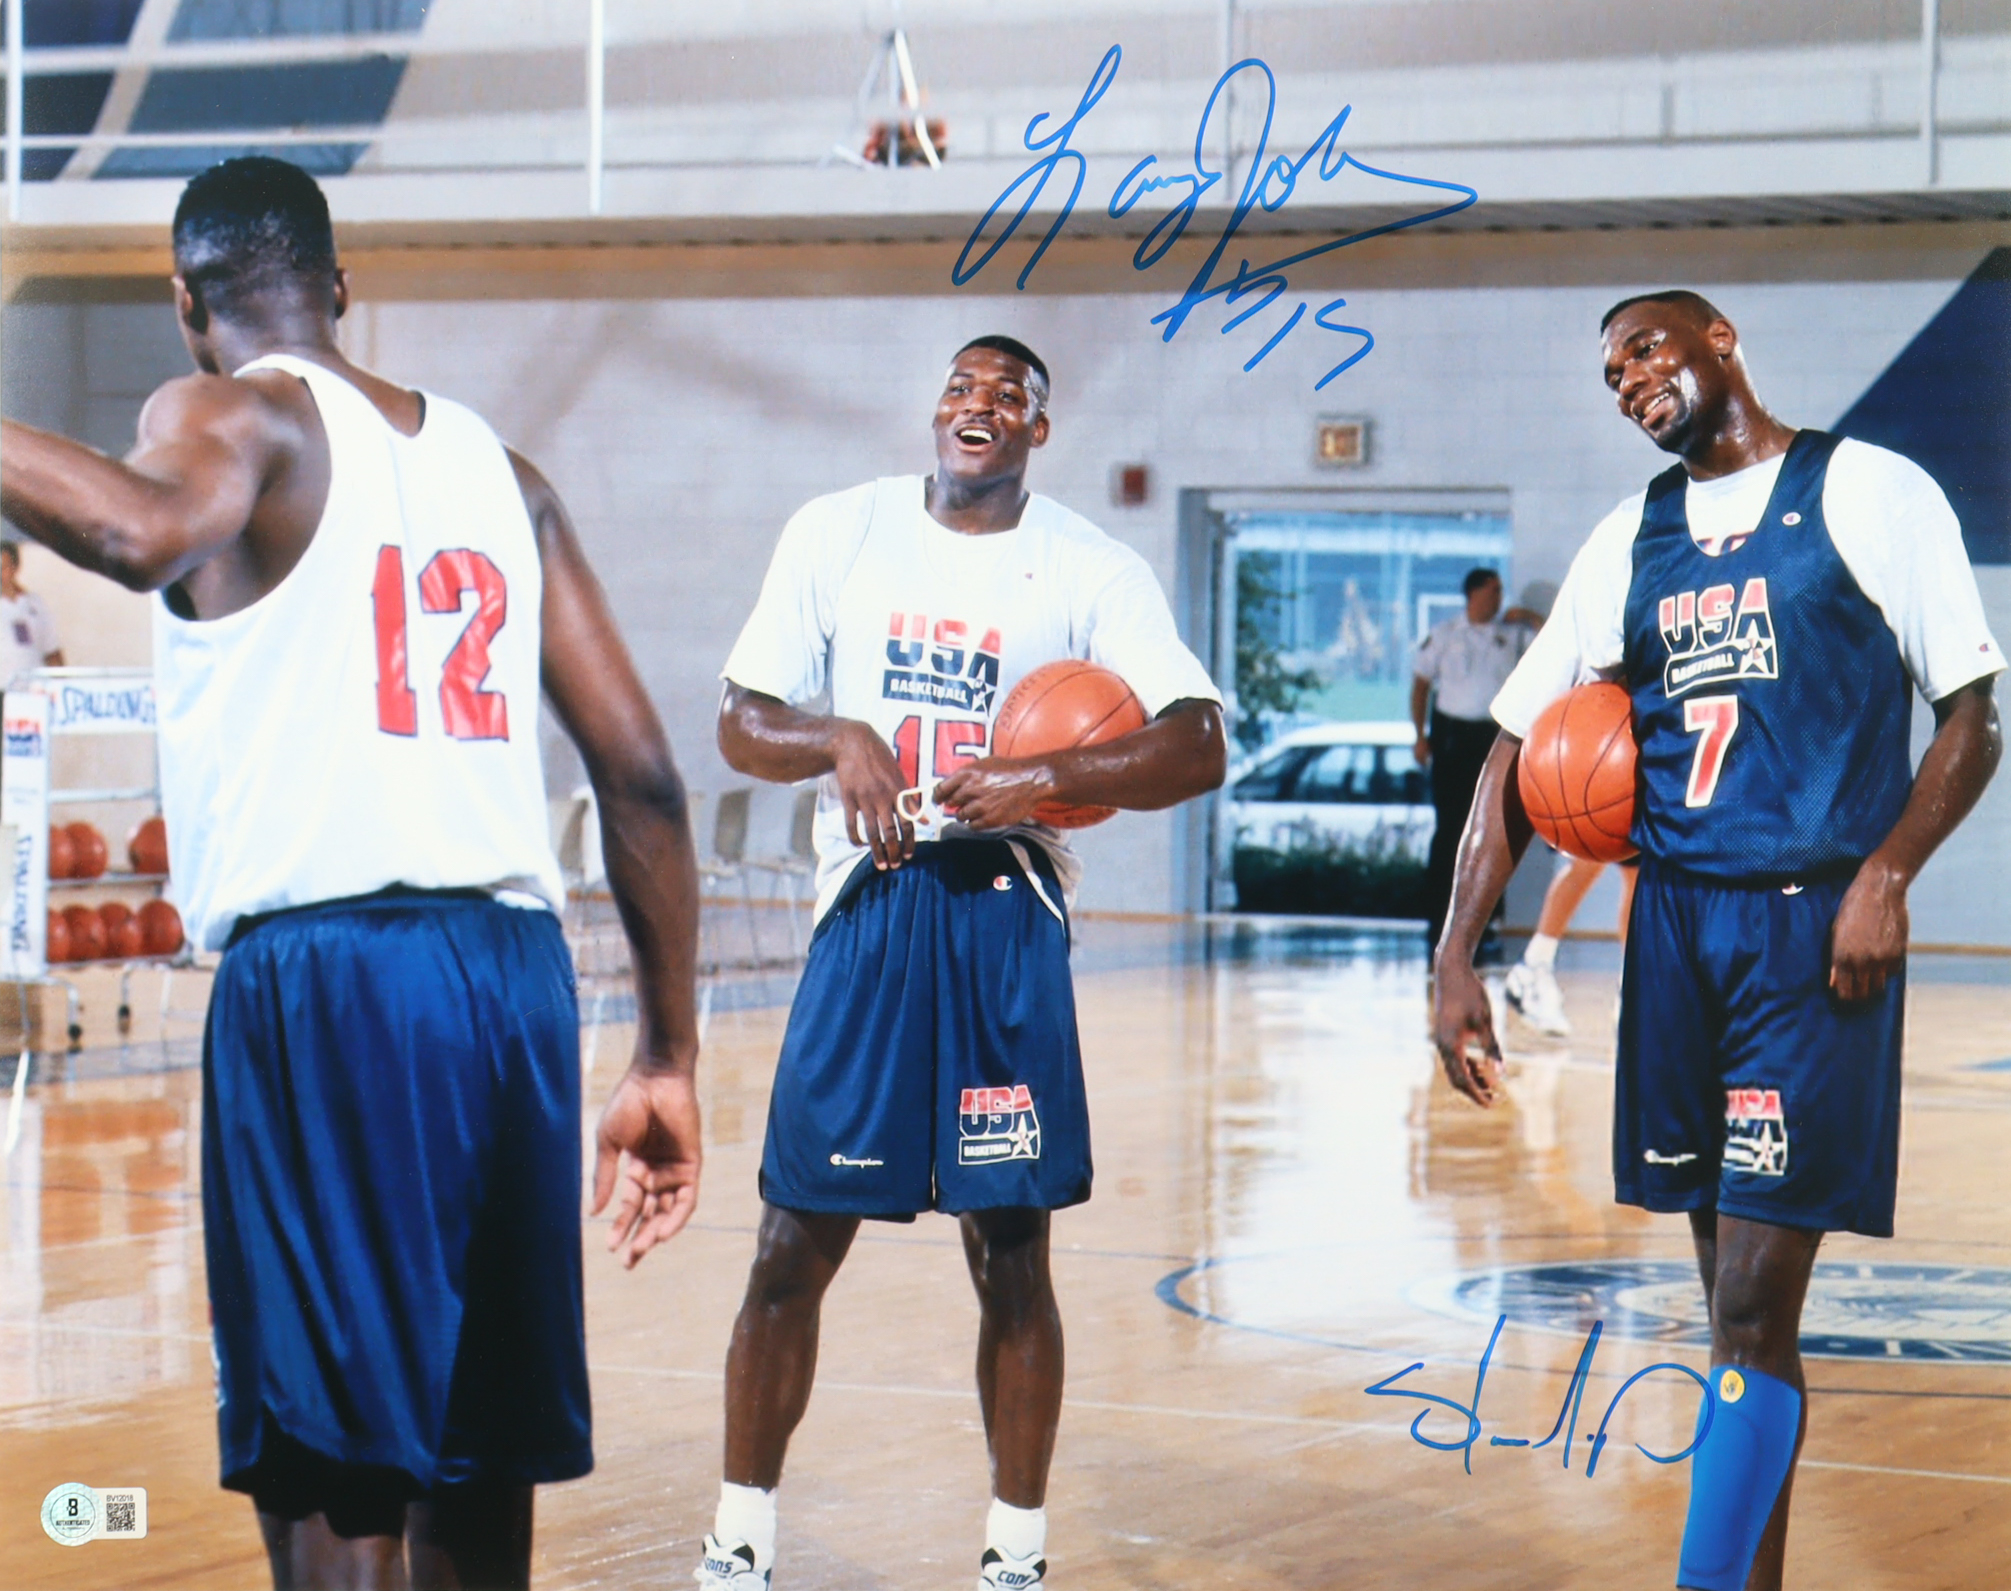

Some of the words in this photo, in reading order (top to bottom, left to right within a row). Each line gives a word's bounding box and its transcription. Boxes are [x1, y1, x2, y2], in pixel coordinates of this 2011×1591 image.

[371, 543, 509, 742] 12
[886, 612, 1003, 687] USA
[1659, 577, 1776, 657] USA
[889, 678, 968, 704] BASKETBALL
[1684, 694, 1739, 809] 7
[959, 1084, 1041, 1138] USA
